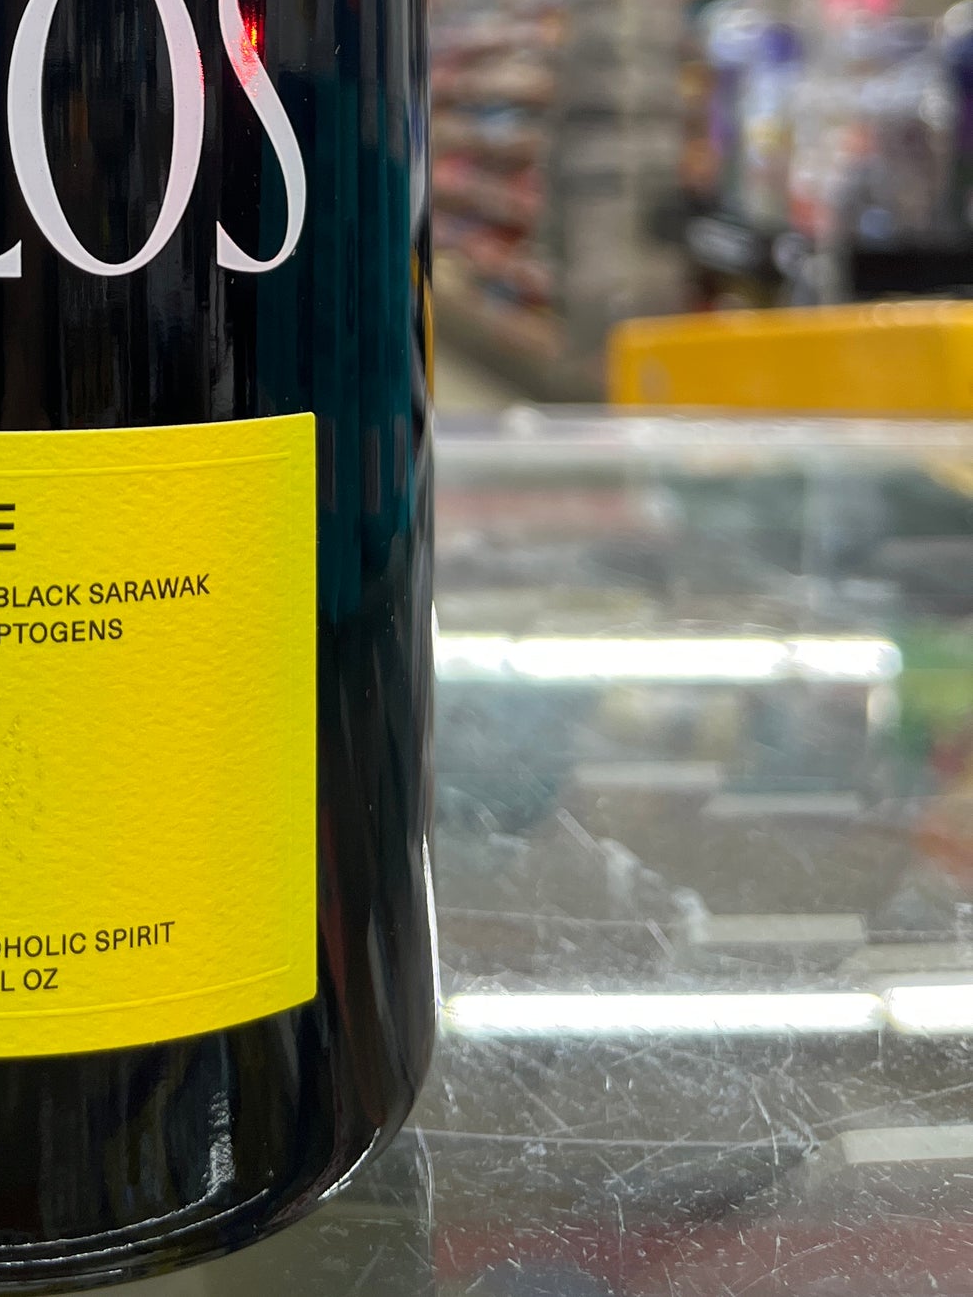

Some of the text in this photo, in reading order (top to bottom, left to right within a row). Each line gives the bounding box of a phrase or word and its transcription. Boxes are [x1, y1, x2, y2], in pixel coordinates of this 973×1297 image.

[88, 573, 211, 607] SARAWAK
[94, 920, 176, 953] SPIRIT
[22, 967, 59, 992] OZ
